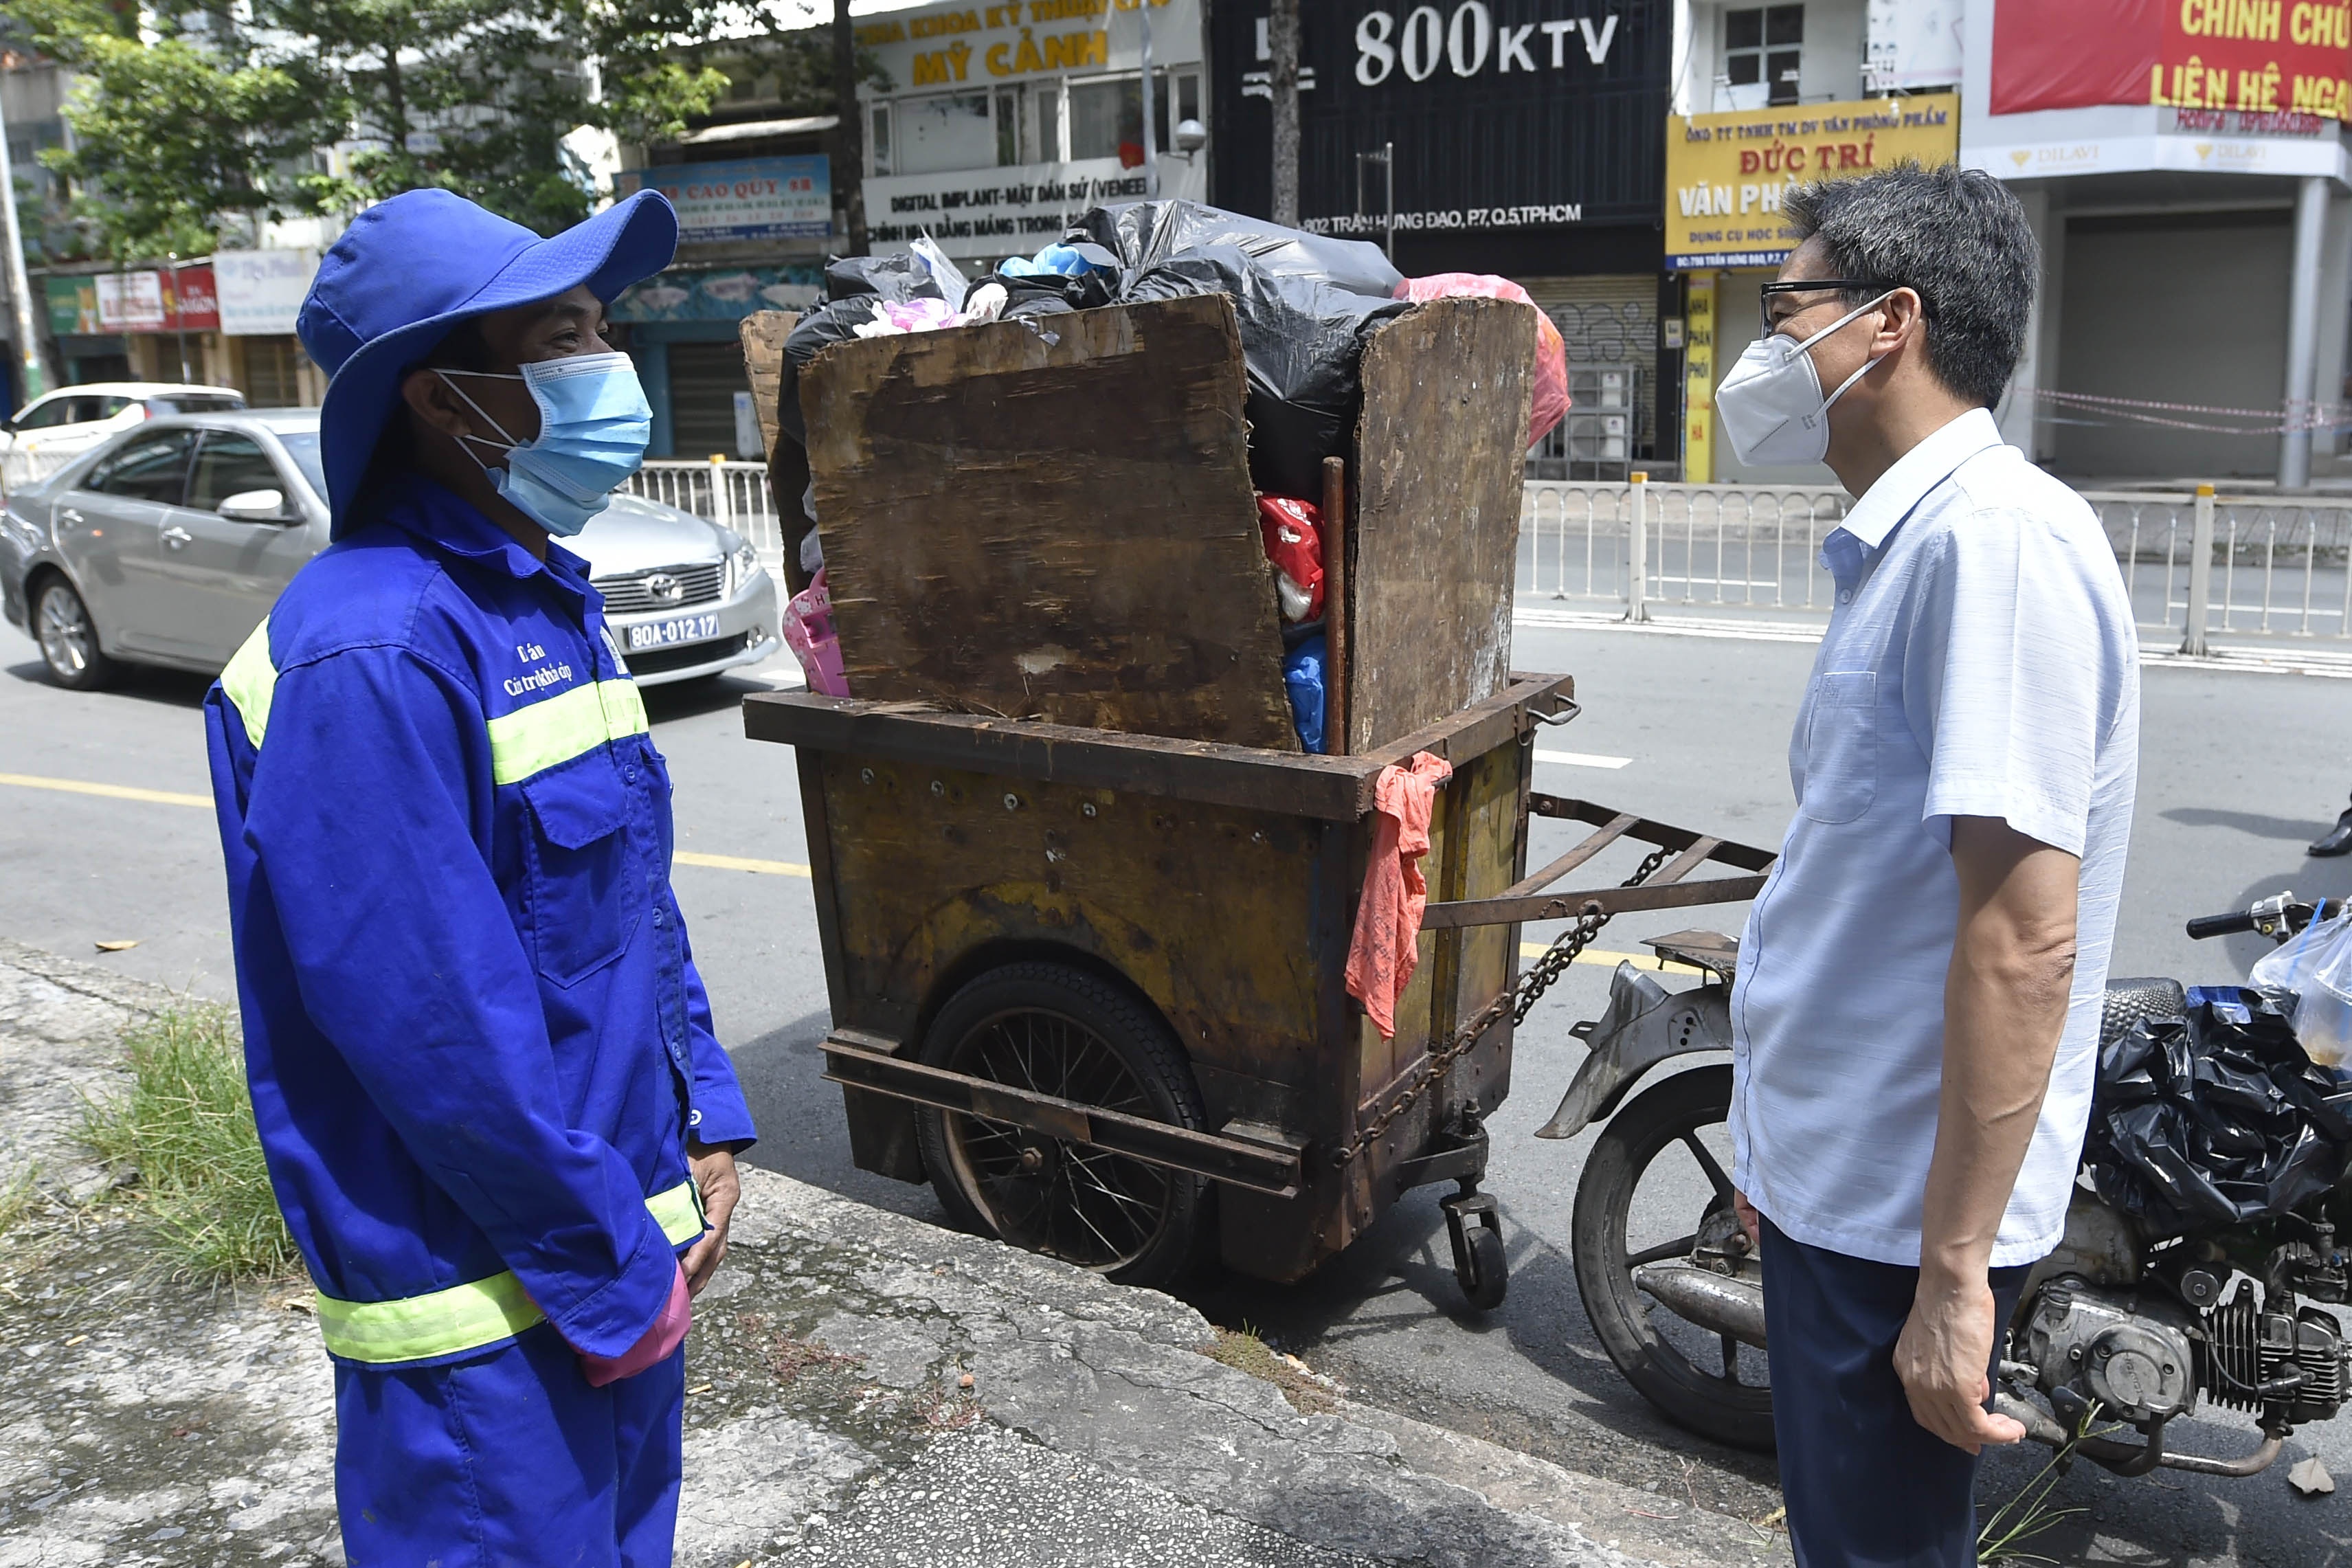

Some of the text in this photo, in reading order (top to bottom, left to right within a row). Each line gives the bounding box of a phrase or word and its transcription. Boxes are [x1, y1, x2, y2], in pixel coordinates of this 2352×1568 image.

[909, 10, 981, 40] KHOA
[1355, 0, 1490, 86] 800
[1499, 14, 1619, 73] KTV
[985, 27, 1108, 78] CẢNH
[2151, 55, 2229, 110] LIÊN
[1740, 131, 1875, 175] ĐỨC TRÍ
[891, 194, 939, 213] DIGITAL
[1092, 177, 1161, 201] (VENEE)
[1679, 180, 1733, 217] VĂN
[1017, 215, 1063, 234] TRONG
